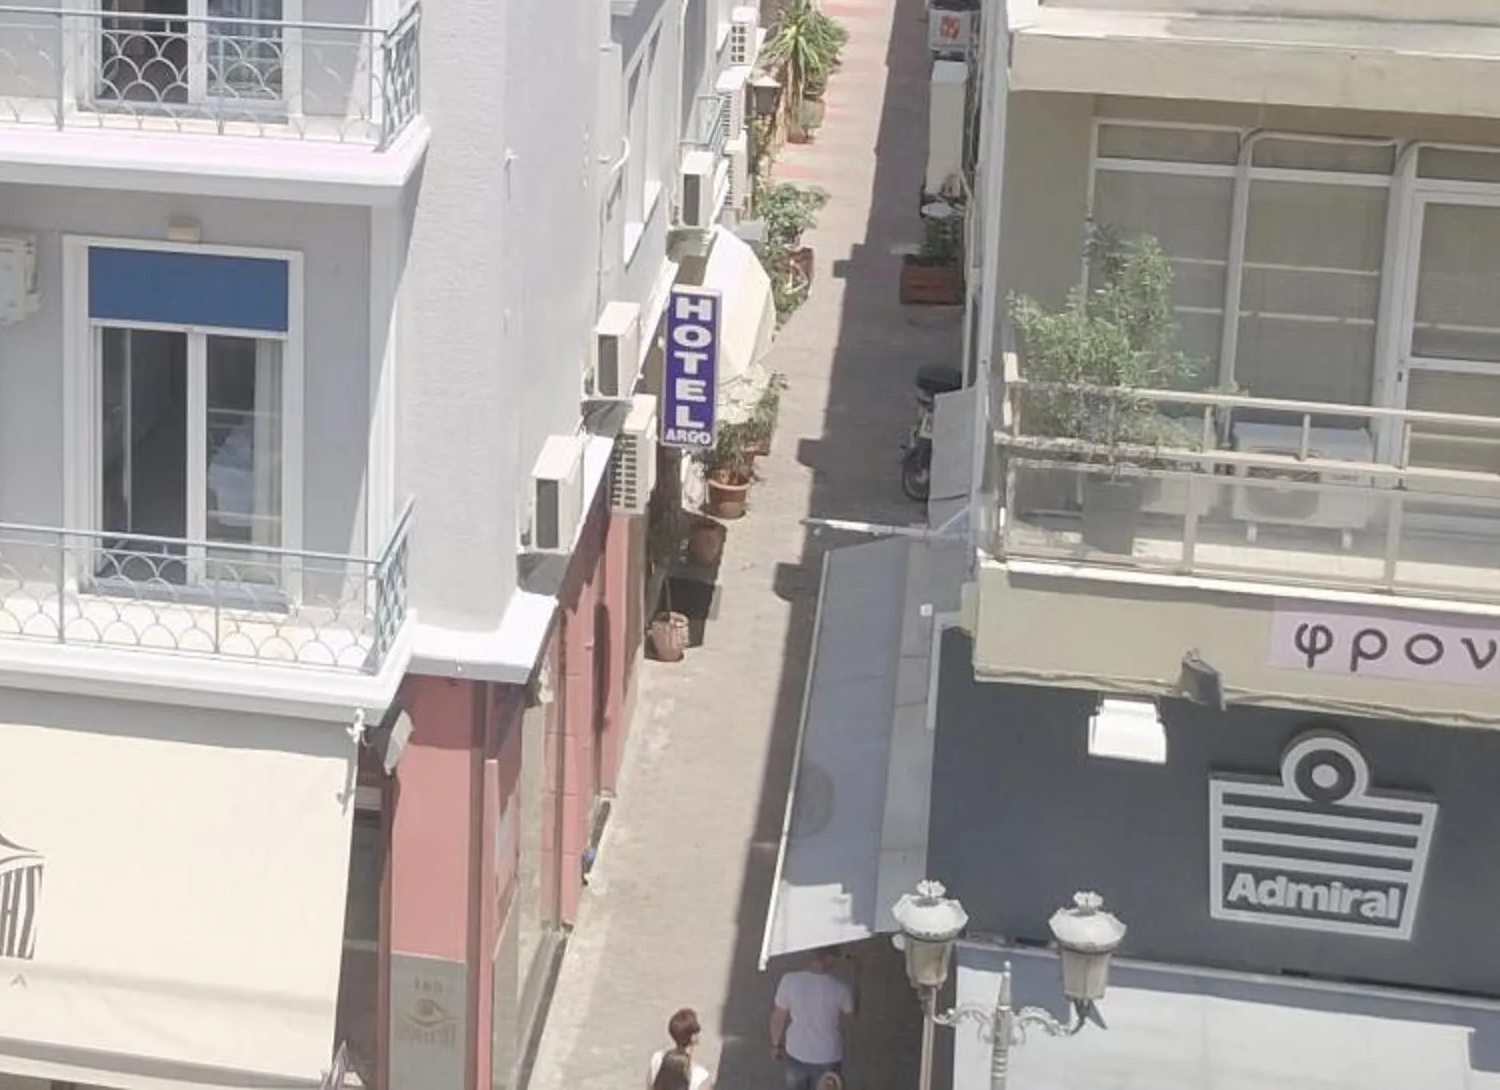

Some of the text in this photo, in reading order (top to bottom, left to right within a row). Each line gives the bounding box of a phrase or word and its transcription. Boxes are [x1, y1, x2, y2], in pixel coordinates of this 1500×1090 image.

[672, 297, 713, 429] HOTEL
[665, 429, 711, 445] ARGO
[1227, 872, 1400, 920] Admiral
